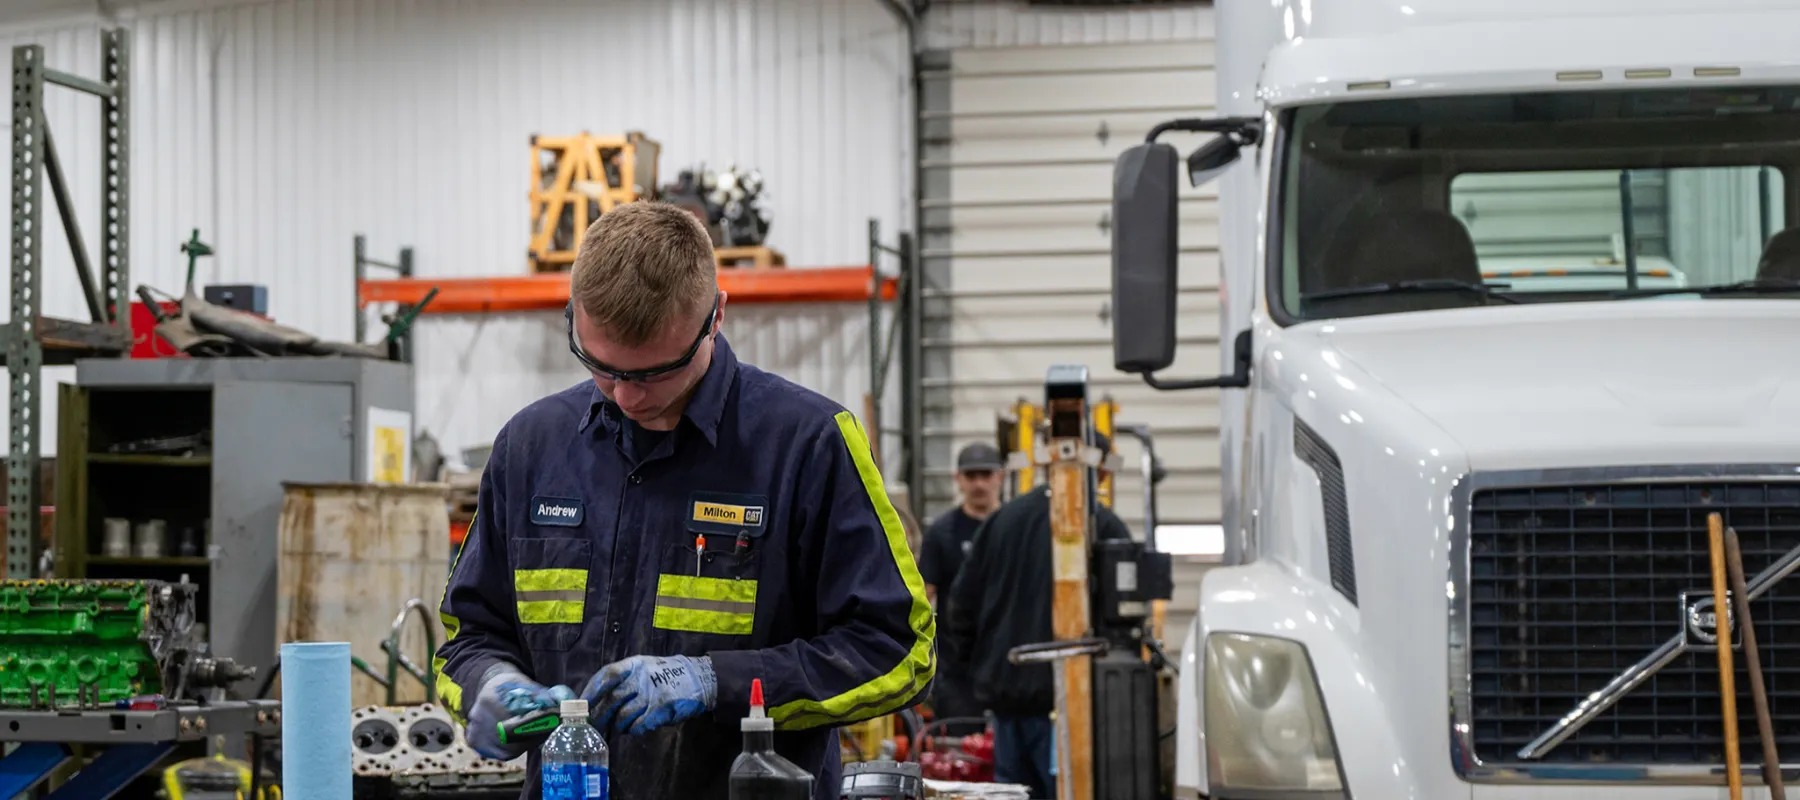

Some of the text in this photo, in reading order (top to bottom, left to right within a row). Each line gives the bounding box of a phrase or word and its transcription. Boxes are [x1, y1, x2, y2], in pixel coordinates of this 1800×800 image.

[537, 503, 577, 518] Andrew
[703, 506, 760, 522] Milton CAT
[650, 667, 685, 687] HyFlex
